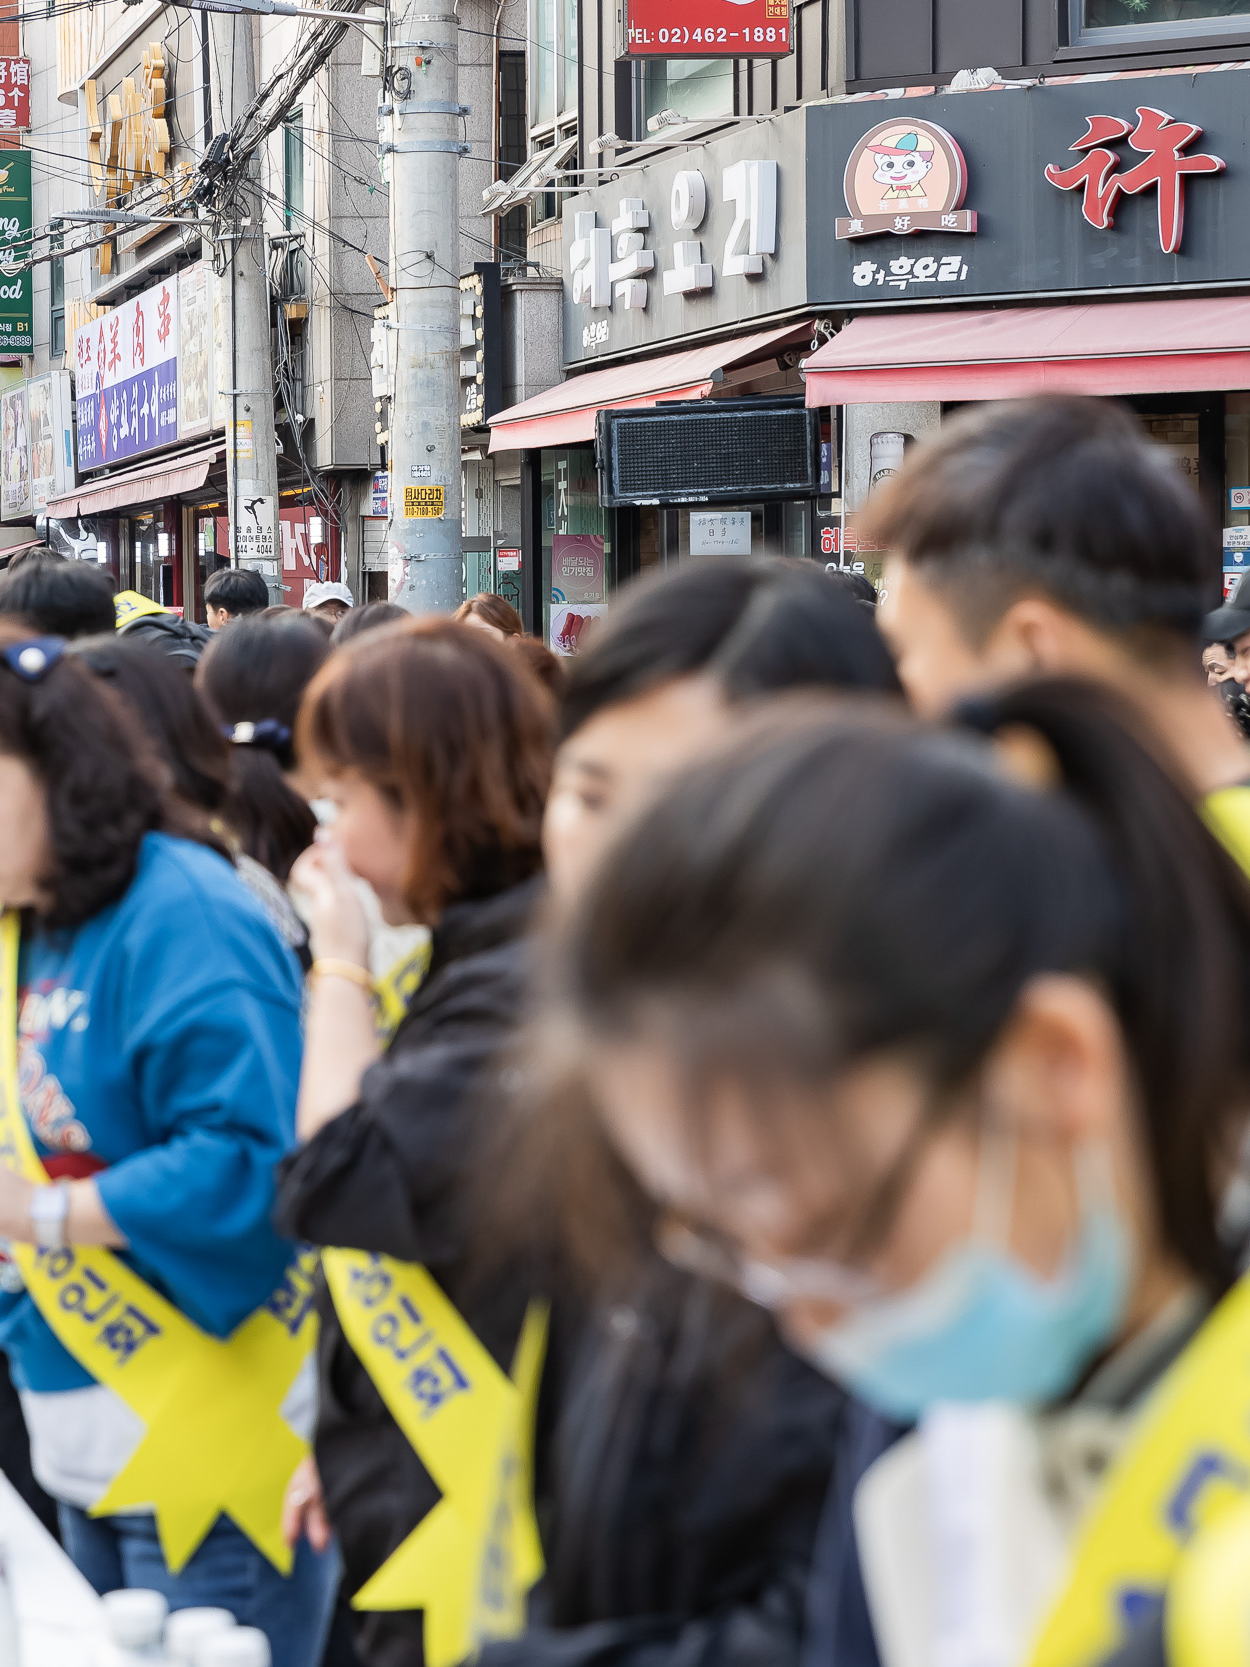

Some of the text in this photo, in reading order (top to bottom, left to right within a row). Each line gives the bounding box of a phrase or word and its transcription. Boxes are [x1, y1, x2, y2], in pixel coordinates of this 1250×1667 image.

[847, 212, 958, 234] 真好吃
[852, 255, 969, 291] 허흑오리
[17, 322, 29, 332] B1
[412, 488, 443, 501] 사다리차
[562, 556, 595, 567] 배달되는
[561, 567, 594, 577] 인기맛집
